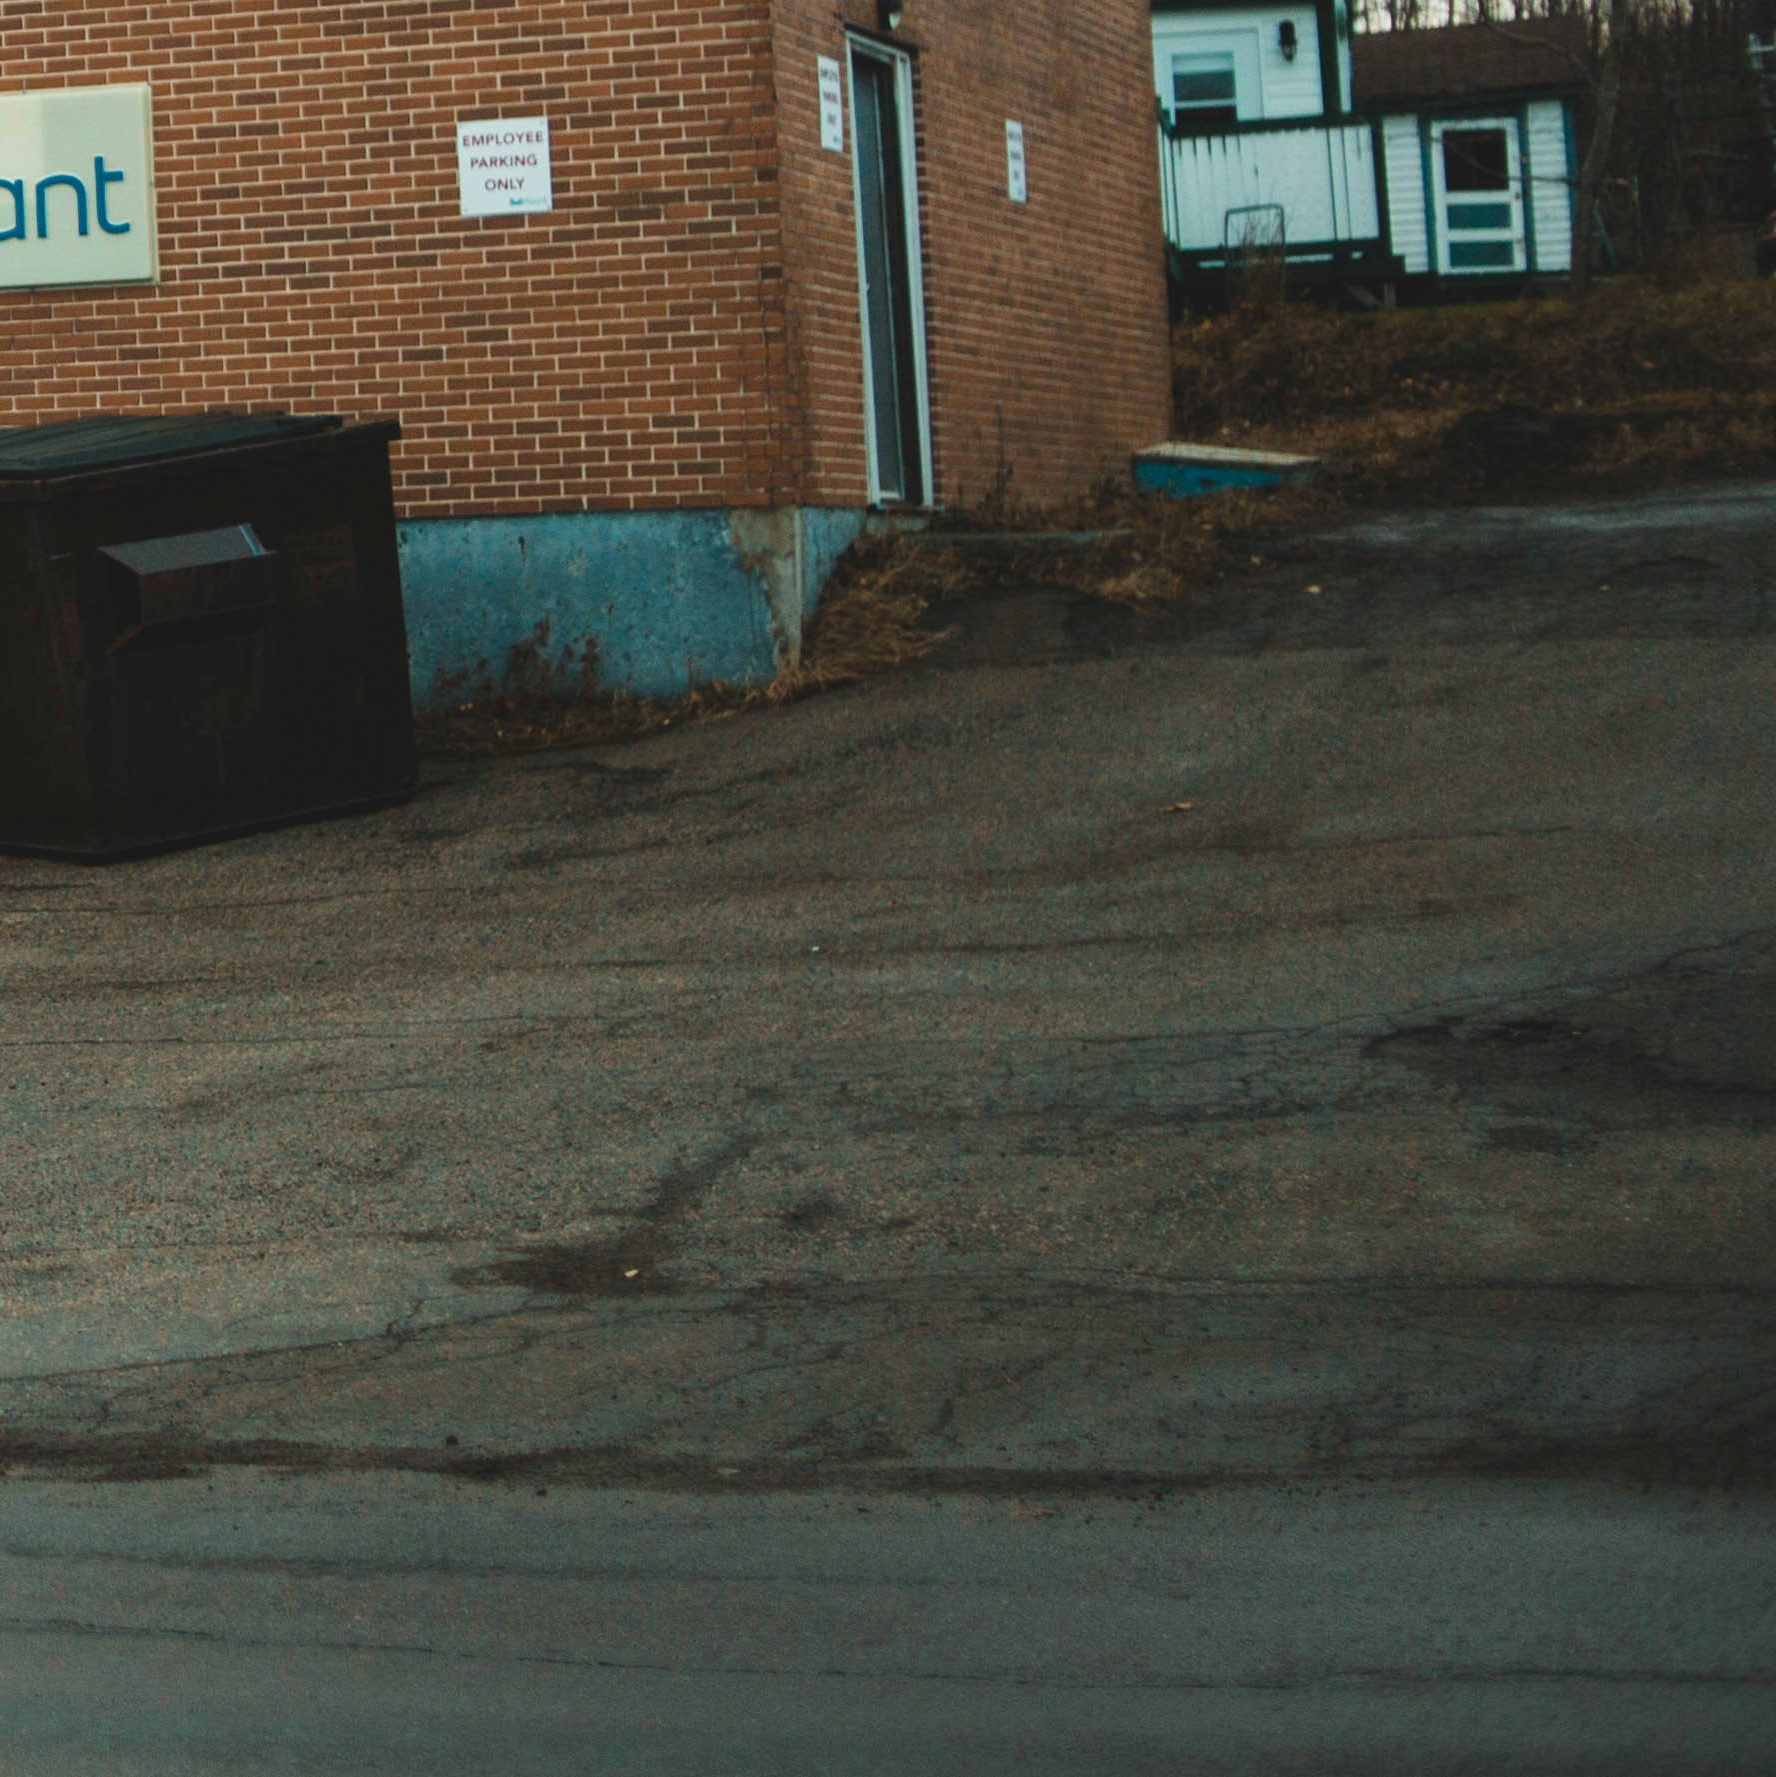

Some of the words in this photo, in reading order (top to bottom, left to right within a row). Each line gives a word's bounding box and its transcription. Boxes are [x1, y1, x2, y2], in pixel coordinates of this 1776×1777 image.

[462, 131, 544, 147] EMPLOYEE
[470, 154, 538, 171] PARKING
[484, 177, 525, 192] ONLY
